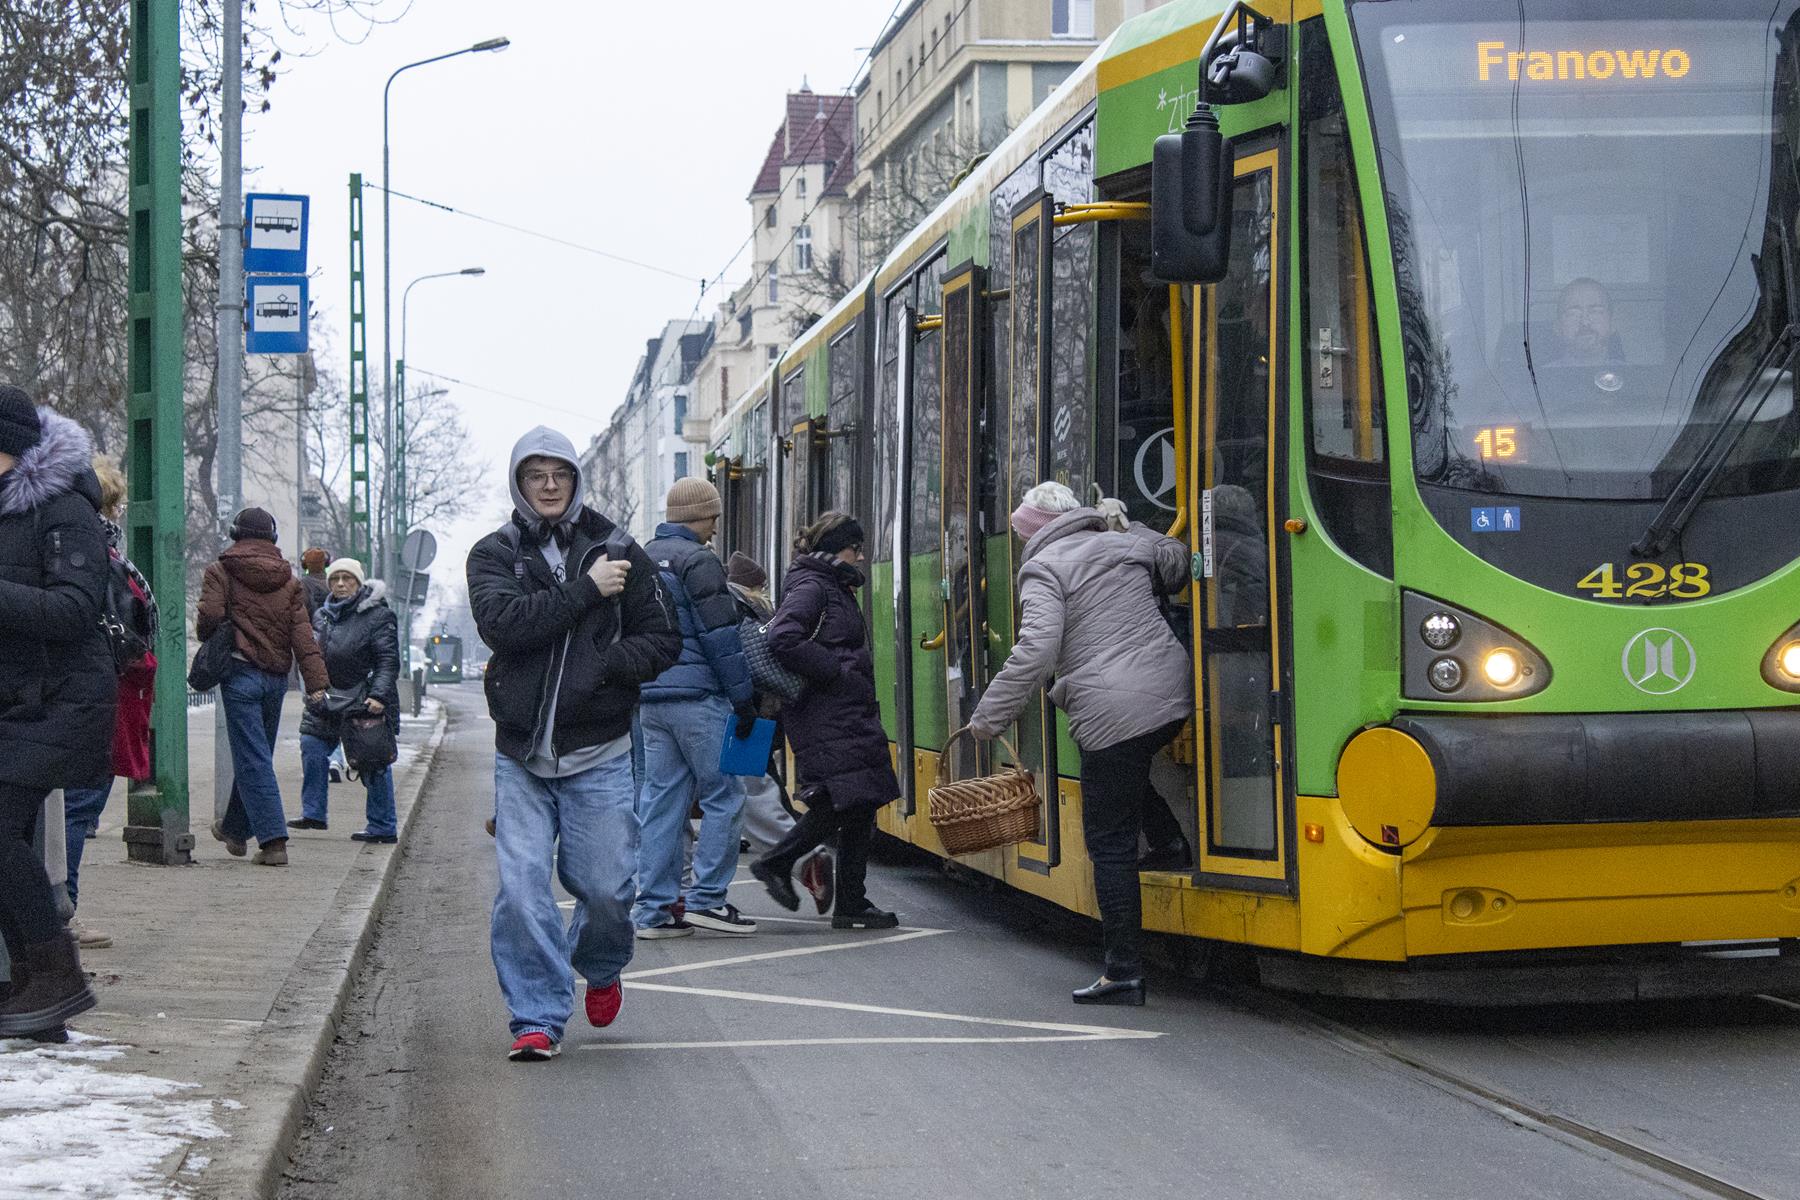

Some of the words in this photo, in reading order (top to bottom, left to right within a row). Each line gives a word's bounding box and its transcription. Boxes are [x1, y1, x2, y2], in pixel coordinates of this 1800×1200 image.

[1477, 41, 1690, 80] Franowo
[1474, 428, 1516, 457] 15
[1576, 562, 1711, 598] 428
